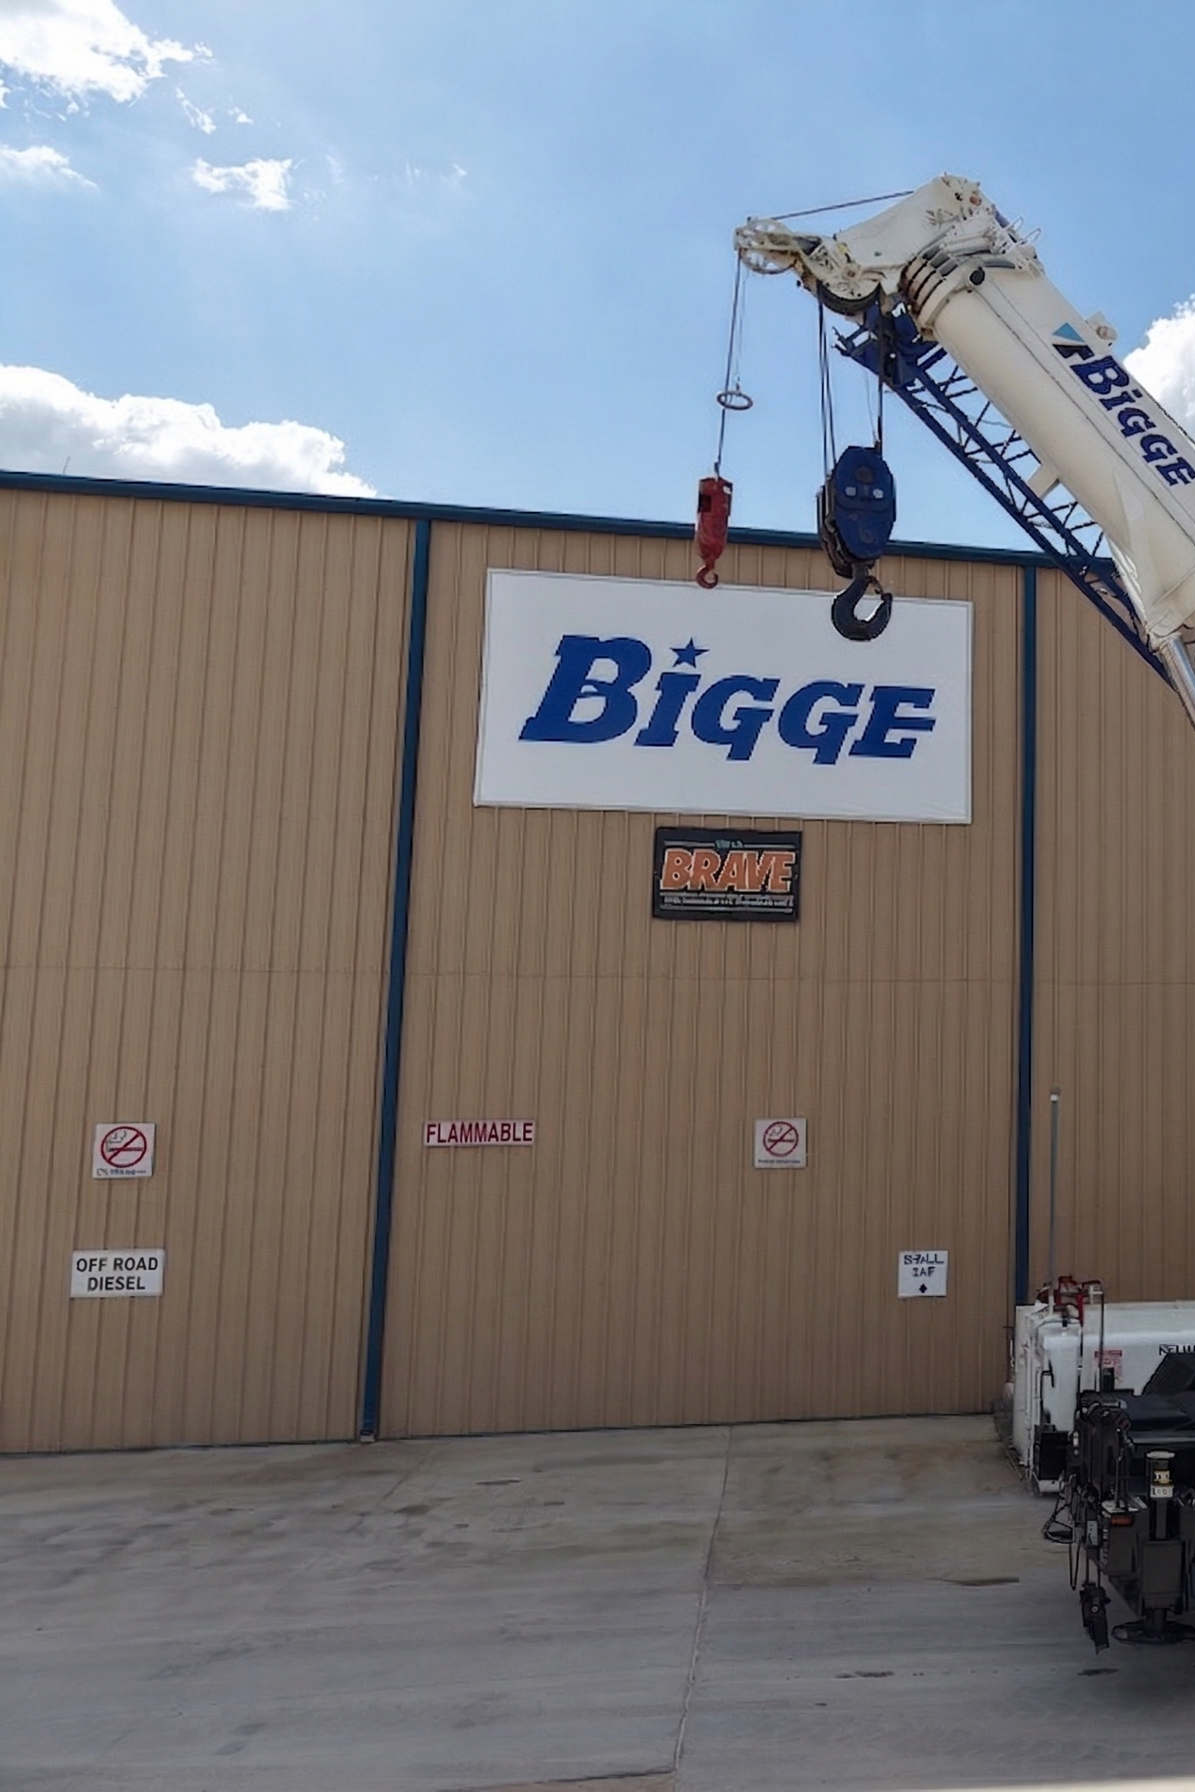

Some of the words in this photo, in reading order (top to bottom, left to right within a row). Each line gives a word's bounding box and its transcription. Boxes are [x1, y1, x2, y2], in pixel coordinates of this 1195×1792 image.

[660, 848, 796, 893] BRAVE
[426, 1121, 534, 1144] FLAMMABLE
[76, 1257, 108, 1272] OFF
[113, 1256, 159, 1271] ROAD
[87, 1276, 146, 1292] DIESEL
